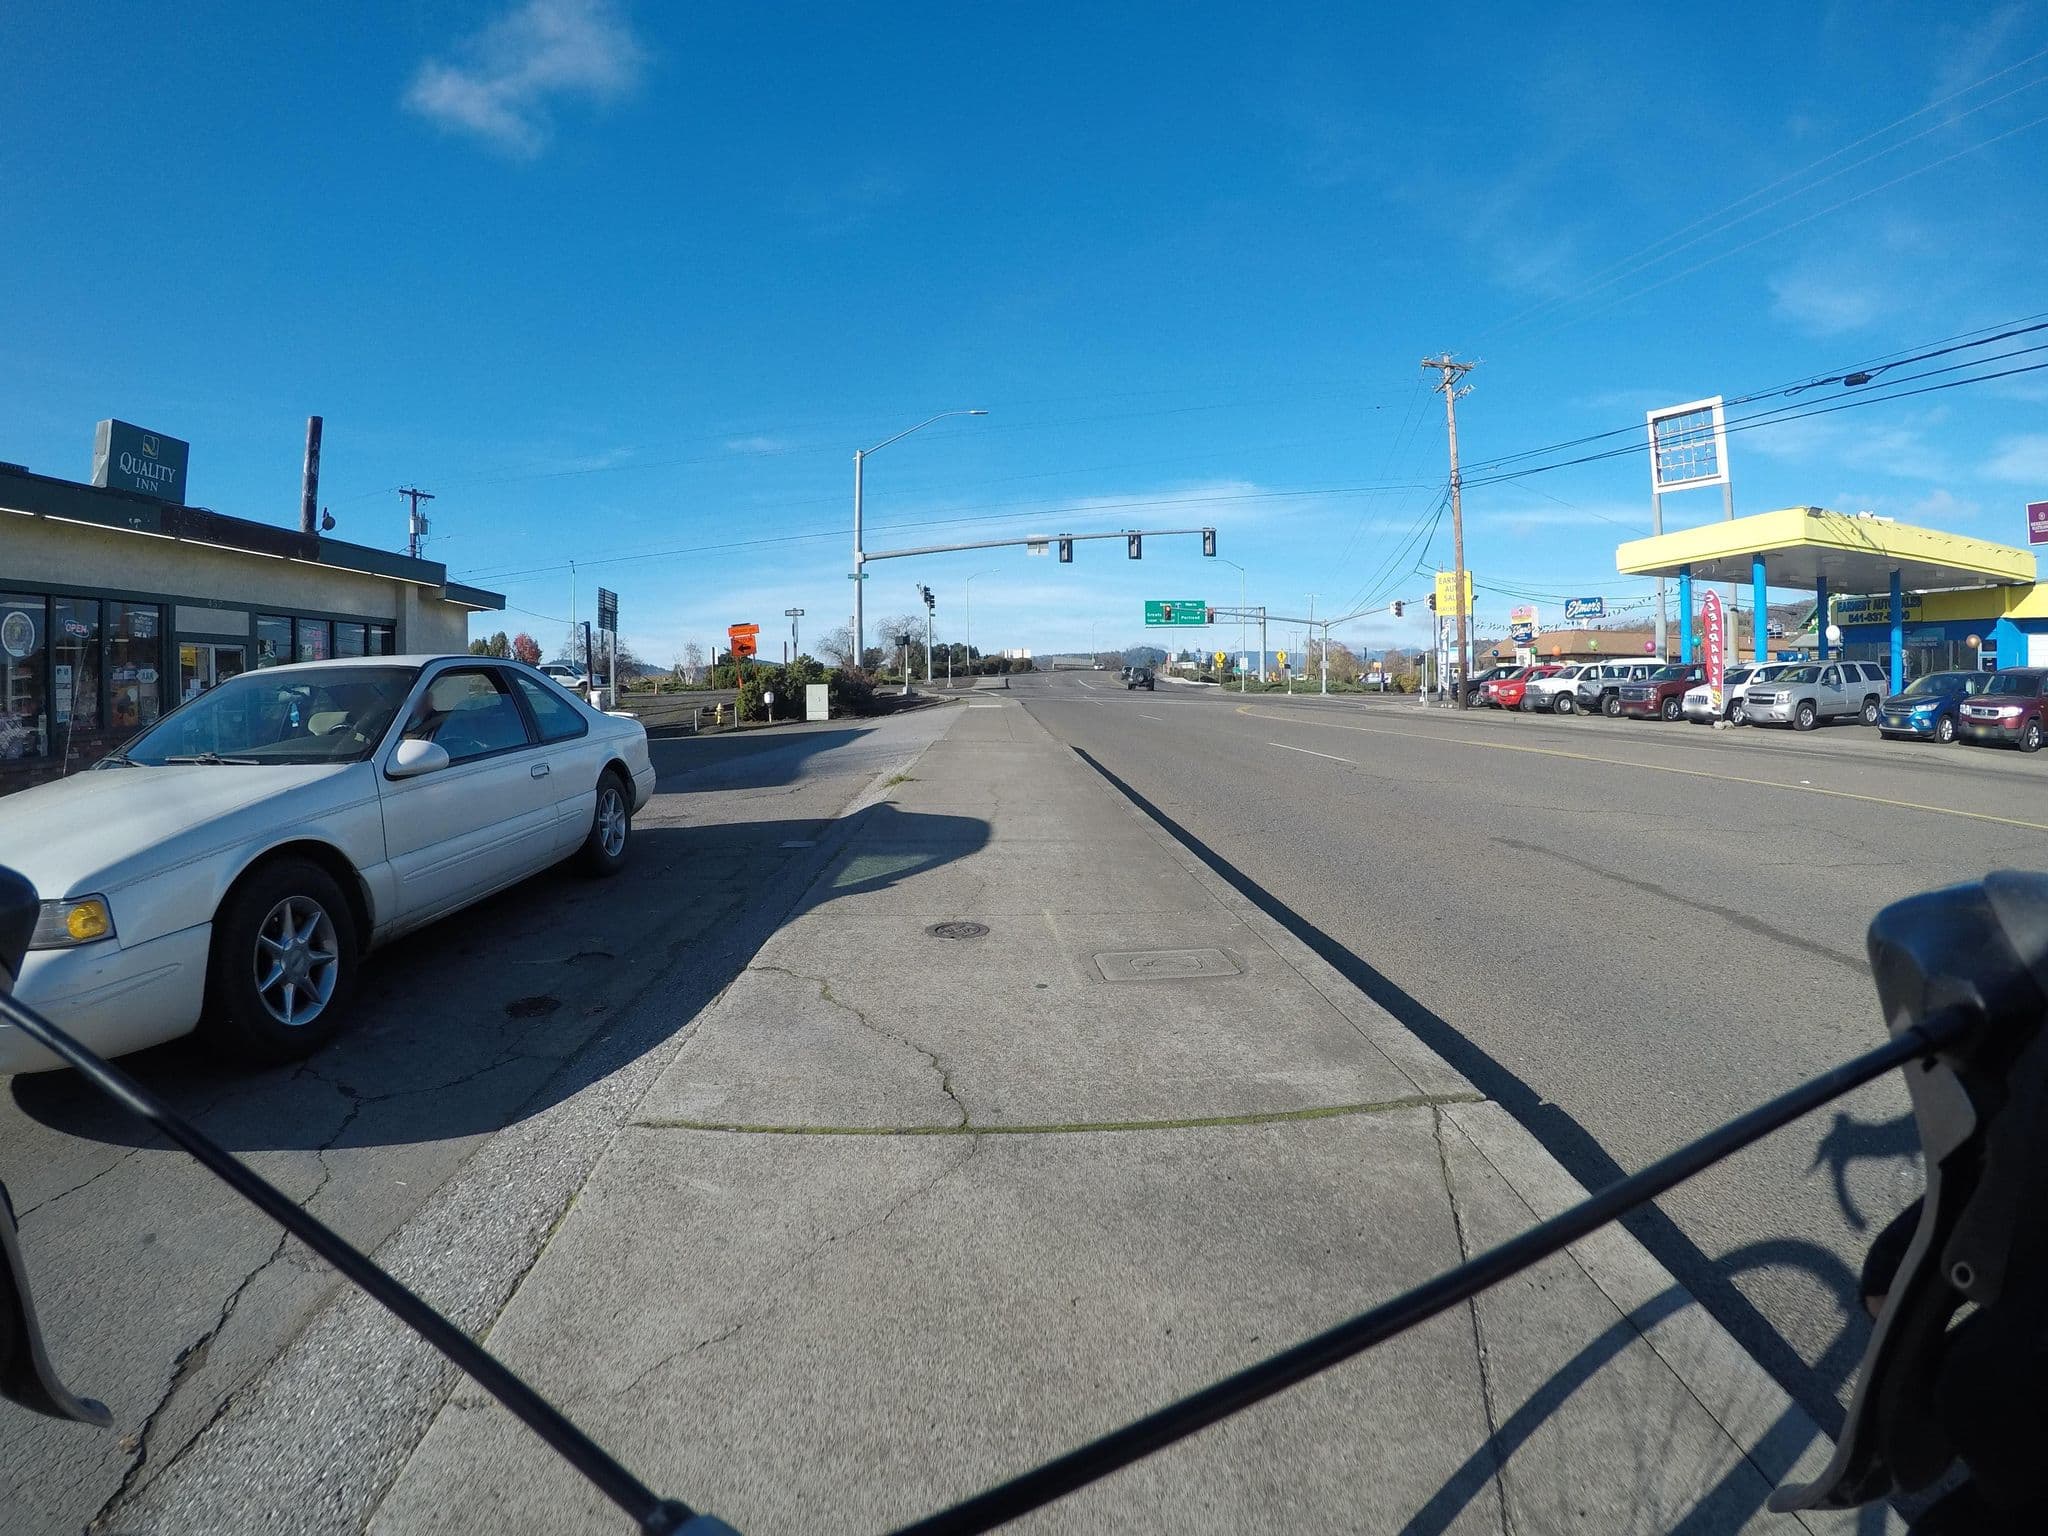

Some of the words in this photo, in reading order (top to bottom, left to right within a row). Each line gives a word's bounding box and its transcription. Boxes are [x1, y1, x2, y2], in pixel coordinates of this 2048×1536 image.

[120, 451, 176, 483] QUALITY
[136, 477, 159, 492] INN
[1566, 599, 1602, 618] Elmer's
[65, 622, 89, 633] OPEN
[1705, 594, 1720, 687] CLEARANCE
